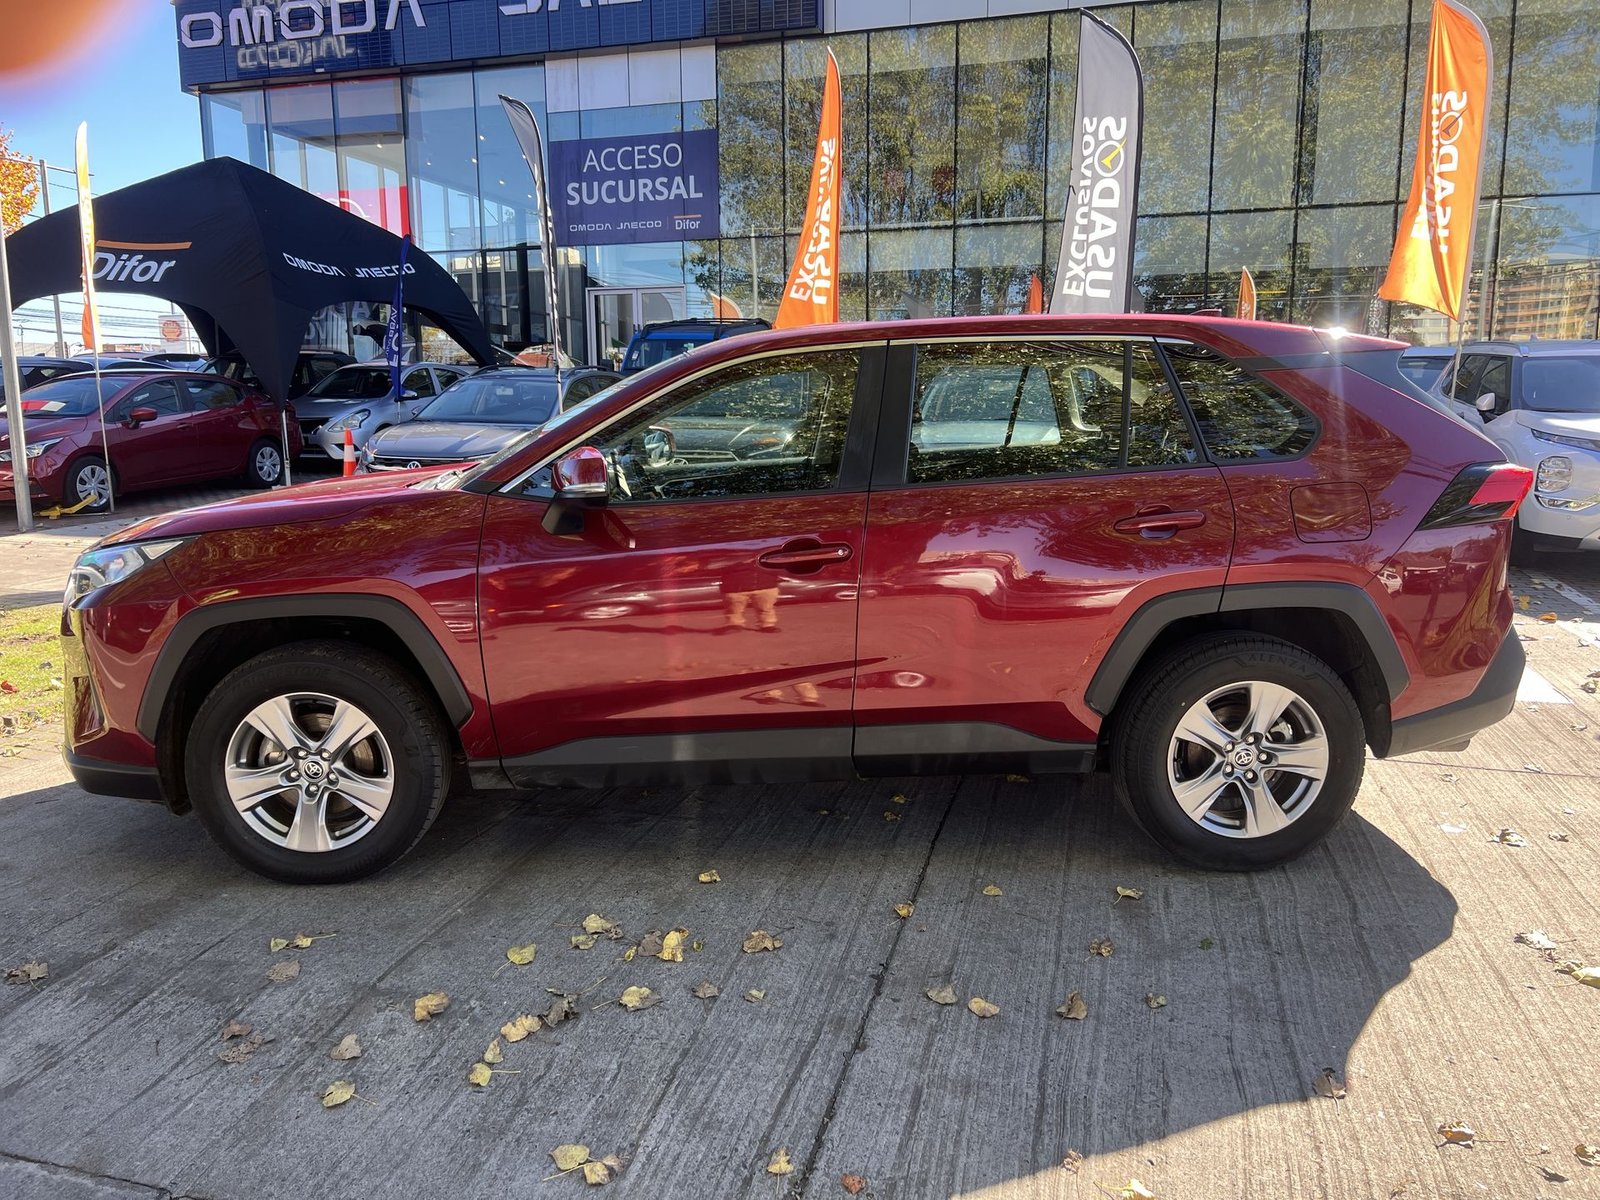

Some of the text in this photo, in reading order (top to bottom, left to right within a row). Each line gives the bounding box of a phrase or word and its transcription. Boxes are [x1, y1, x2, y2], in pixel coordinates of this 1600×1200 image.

[181, 0, 426, 48] OMODA
[583, 143, 683, 173] ACCESO
[567, 175, 703, 206] SUCURSAL
[569, 219, 701, 232] OMODA JAECOO Difor
[81, 252, 176, 283] Difor
[283, 252, 346, 277] OMODA
